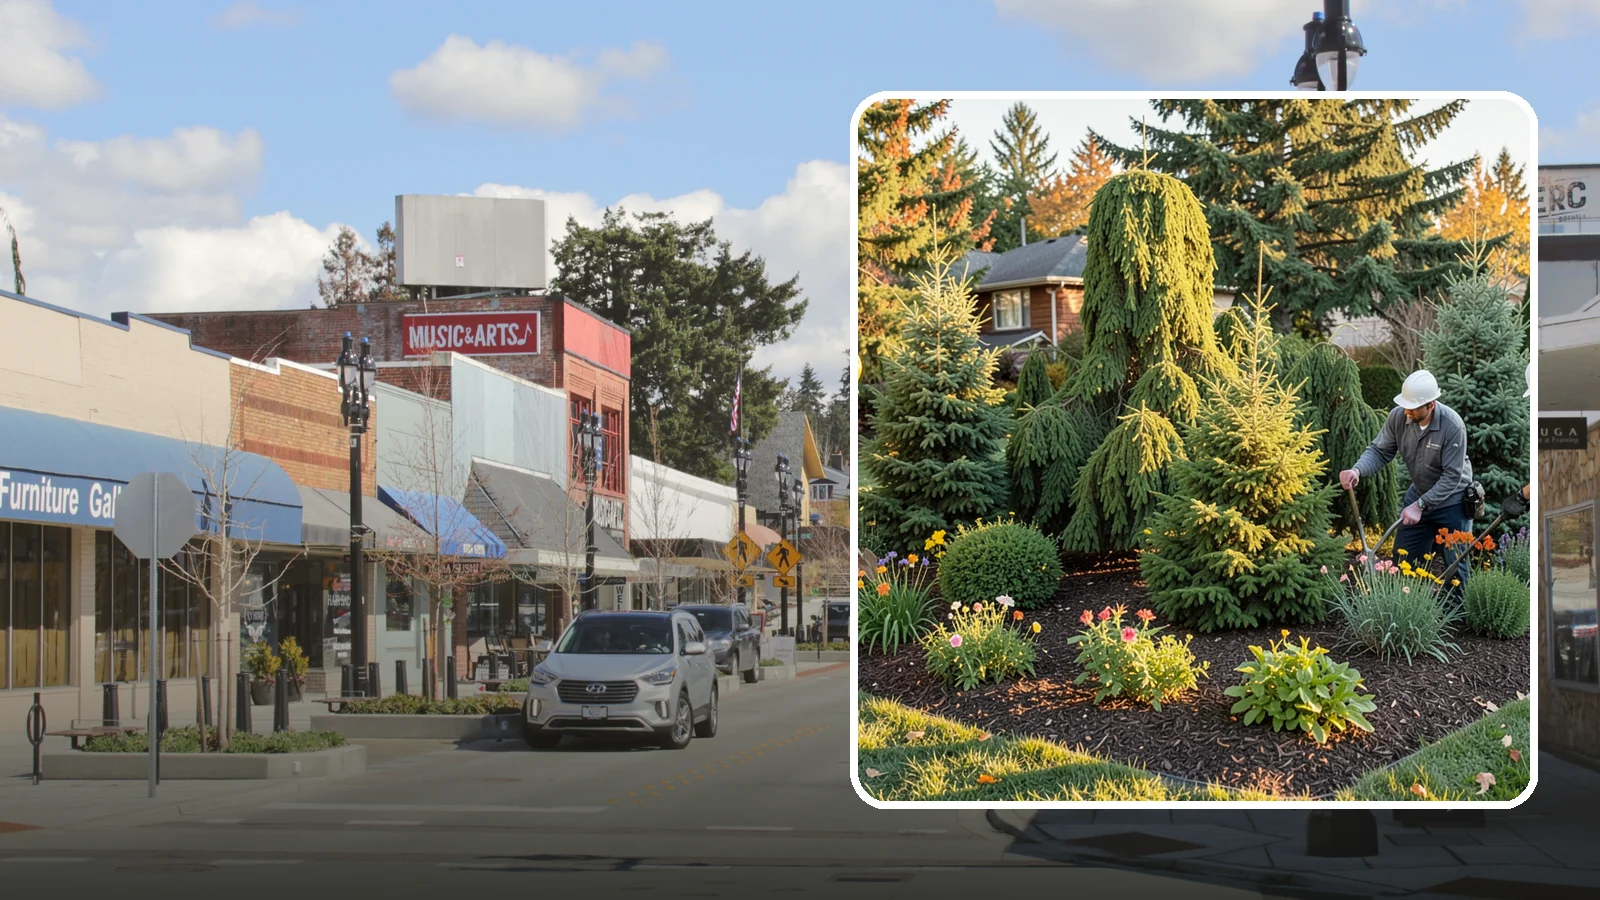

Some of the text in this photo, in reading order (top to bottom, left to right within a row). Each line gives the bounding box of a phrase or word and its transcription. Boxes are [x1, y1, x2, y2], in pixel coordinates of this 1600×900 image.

[0, 471, 122, 519] Furniture Gal
[453, 563, 479, 574] SUSHI
